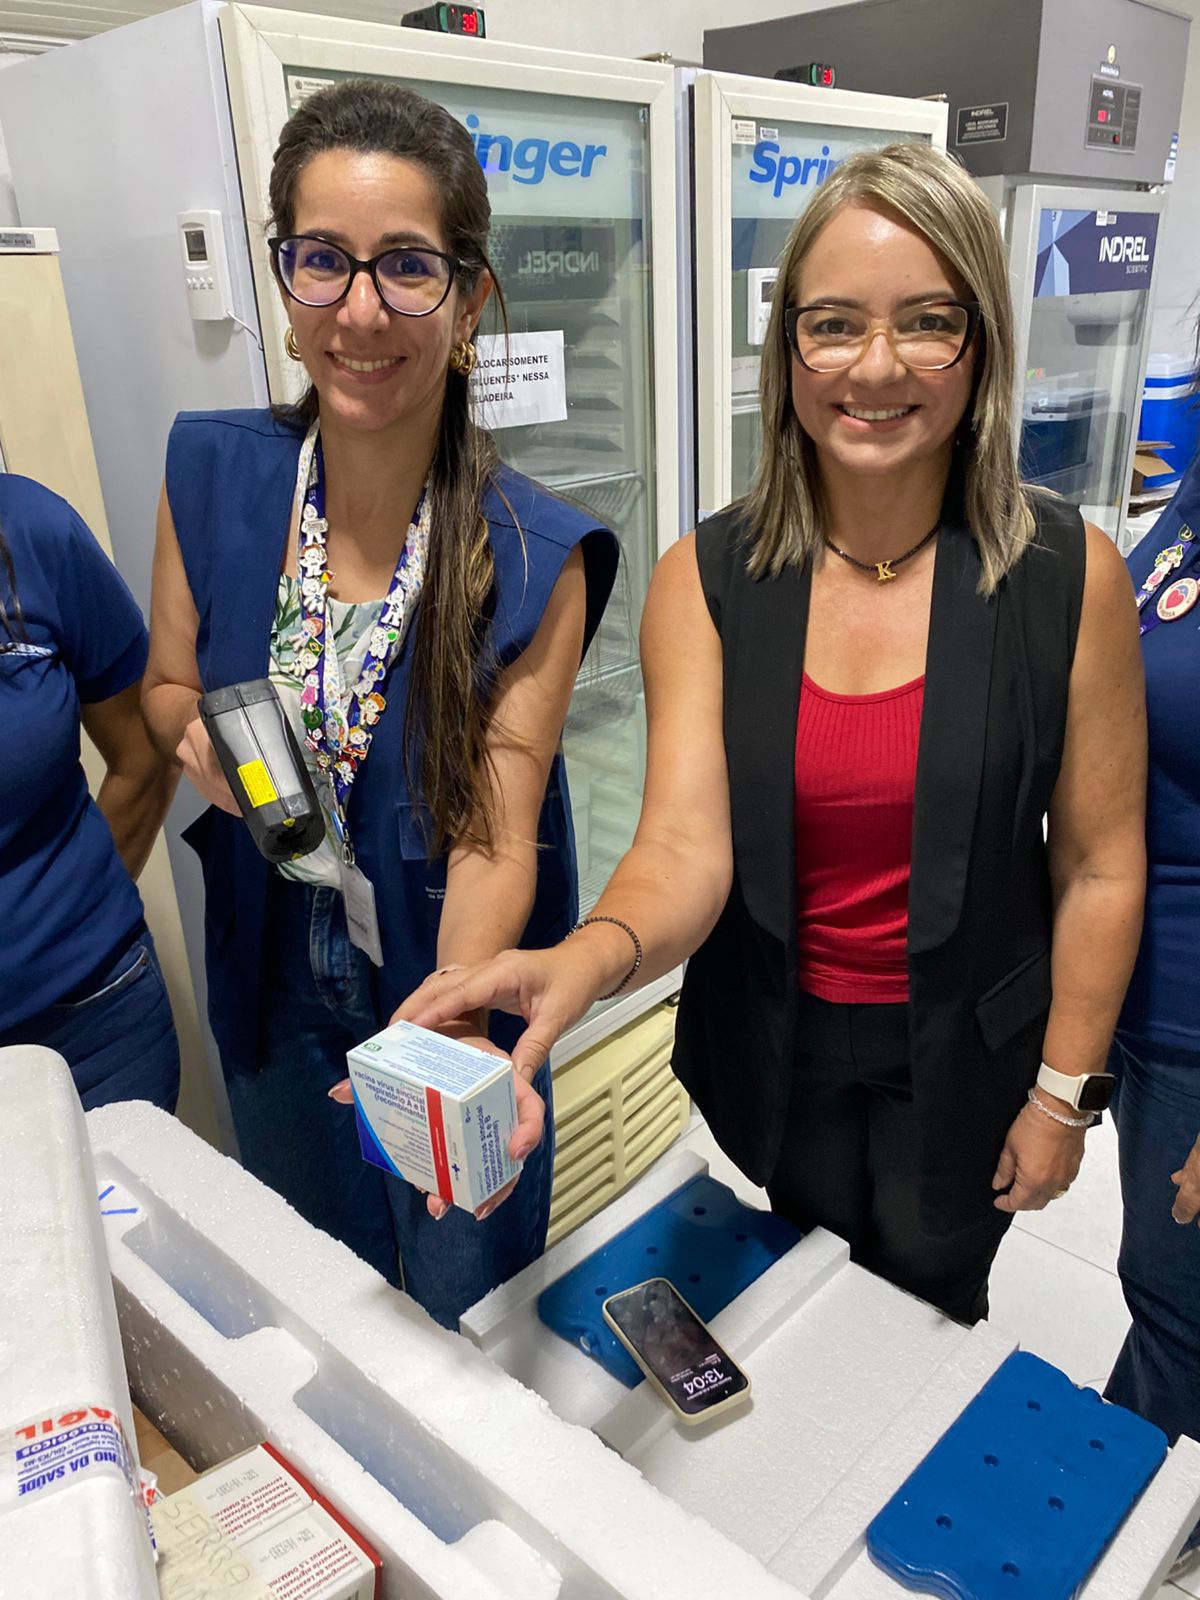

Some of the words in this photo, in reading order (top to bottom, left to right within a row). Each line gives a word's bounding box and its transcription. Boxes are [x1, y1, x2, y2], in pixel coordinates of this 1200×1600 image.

[466, 114, 608, 185] inger
[1099, 236, 1150, 263] INDREL
[509, 354, 549, 367] SOMENTE
[522, 371, 550, 382] NESSA
[470, 391, 514, 404] ELADEIRA
[875, 560, 897, 581] K
[354, 1071, 376, 1084] vacina
[395, 1088, 426, 1105] sincicial
[683, 1367, 724, 1394] 13:04
[69, 1454, 90, 1472] DA
[18, 1465, 66, 1497] SAÚDE
